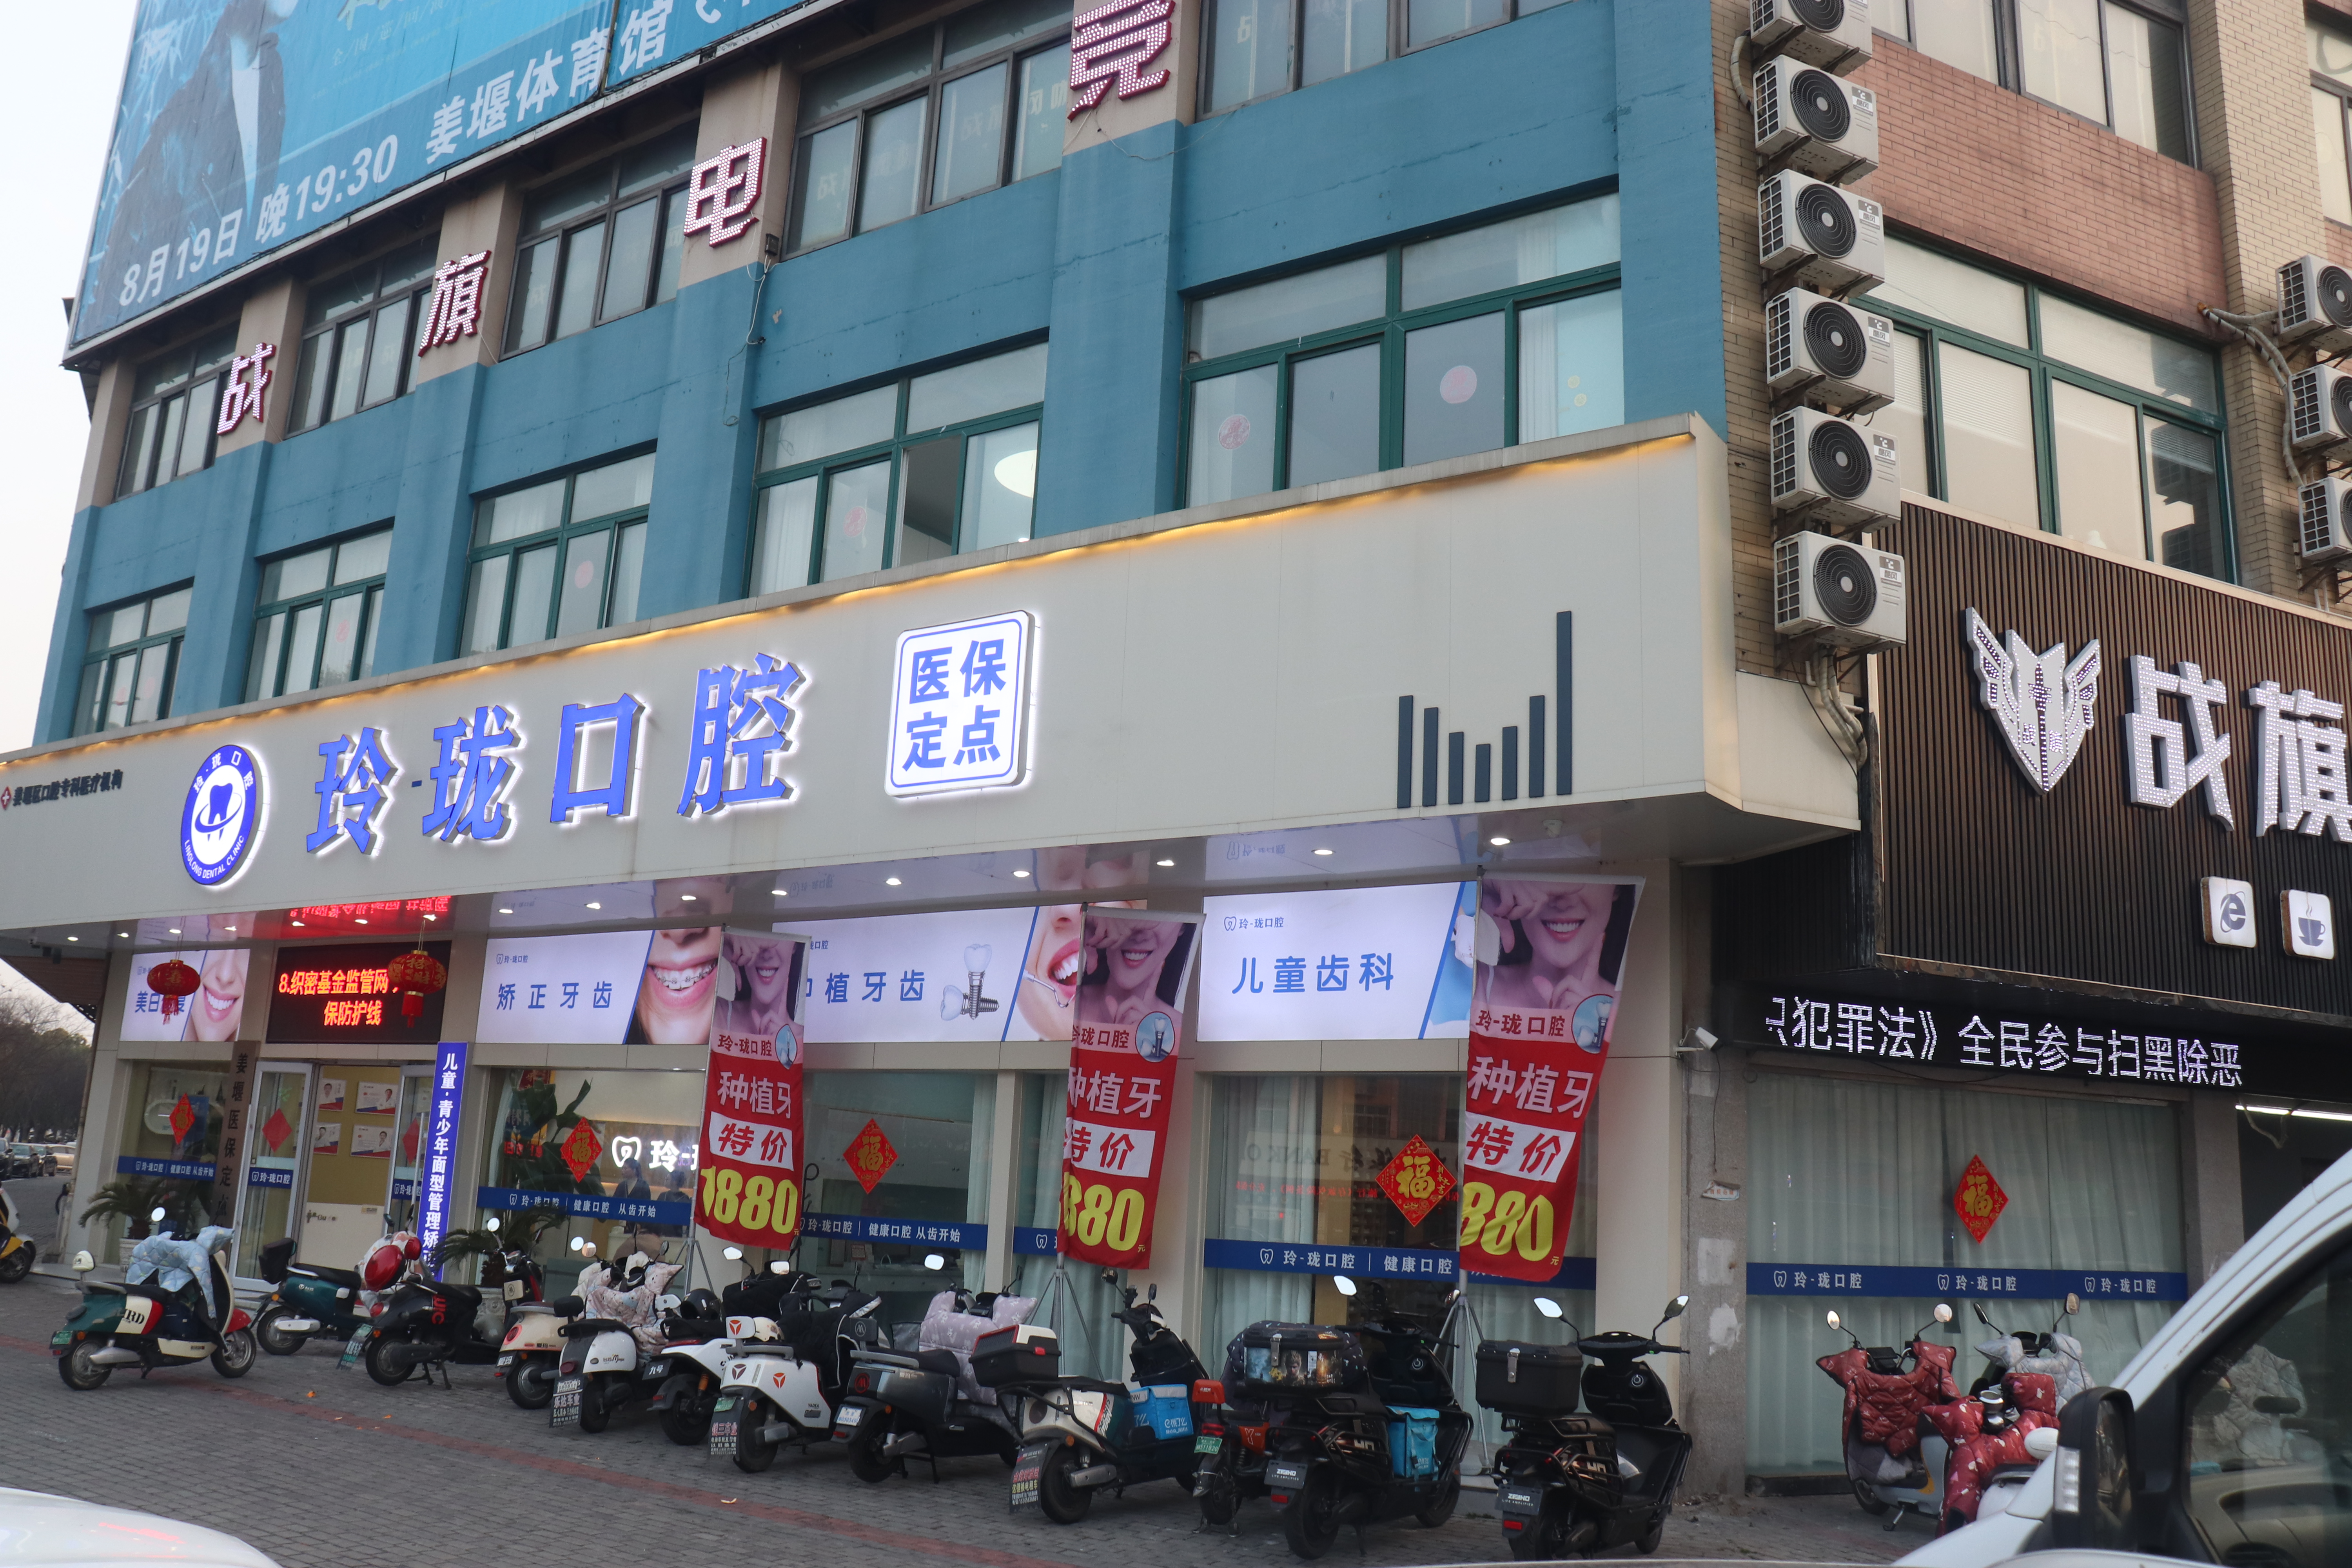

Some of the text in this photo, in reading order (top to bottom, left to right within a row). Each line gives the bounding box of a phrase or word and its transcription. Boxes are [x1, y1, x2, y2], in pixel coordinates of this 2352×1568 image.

[119, 208, 243, 307] 8月19日
[255, 134, 398, 245] 晚19:30
[426, 0, 673, 165] 姜堰体育馆
[684, 137, 767, 247] 电
[909, 638, 1006, 704] 医保
[902, 704, 1001, 772] 定点
[2125, 655, 2352, 843] 战旗
[184, 835, 245, 879] LINGLONG DENTAL CLINIC
[496, 980, 613, 1011] 矫正牙齿
[805, 969, 924, 1004] 植牙齿
[1231, 952, 1394, 995] 儿童齿科
[323, 1000, 382, 1027] 保防护线
[1958, 1015, 2243, 1087] 全民参与扫黑除恶
[717, 1071, 791, 1119] 种植牙
[1067, 1066, 1161, 1119] 种植牙
[1468, 1056, 1594, 1119] 种植牙
[718, 1122, 787, 1163] 特价
[857, 1135, 884, 1171] 福
[1466, 1121, 1562, 1176] 特价
[1396, 1155, 1436, 1199] 福
[1962, 1174, 1993, 1218] 福
[573, 1199, 610, 1214] 健康口腔
[618, 1203, 656, 1218] 从齿开始
[700, 1165, 798, 1234] 1880
[868, 1222, 912, 1240] 健康口腔
[916, 1226, 961, 1243] 从齿开始
[1383, 1255, 1452, 1275] 健康口腔
[649, 1365, 664, 1375] 九号
